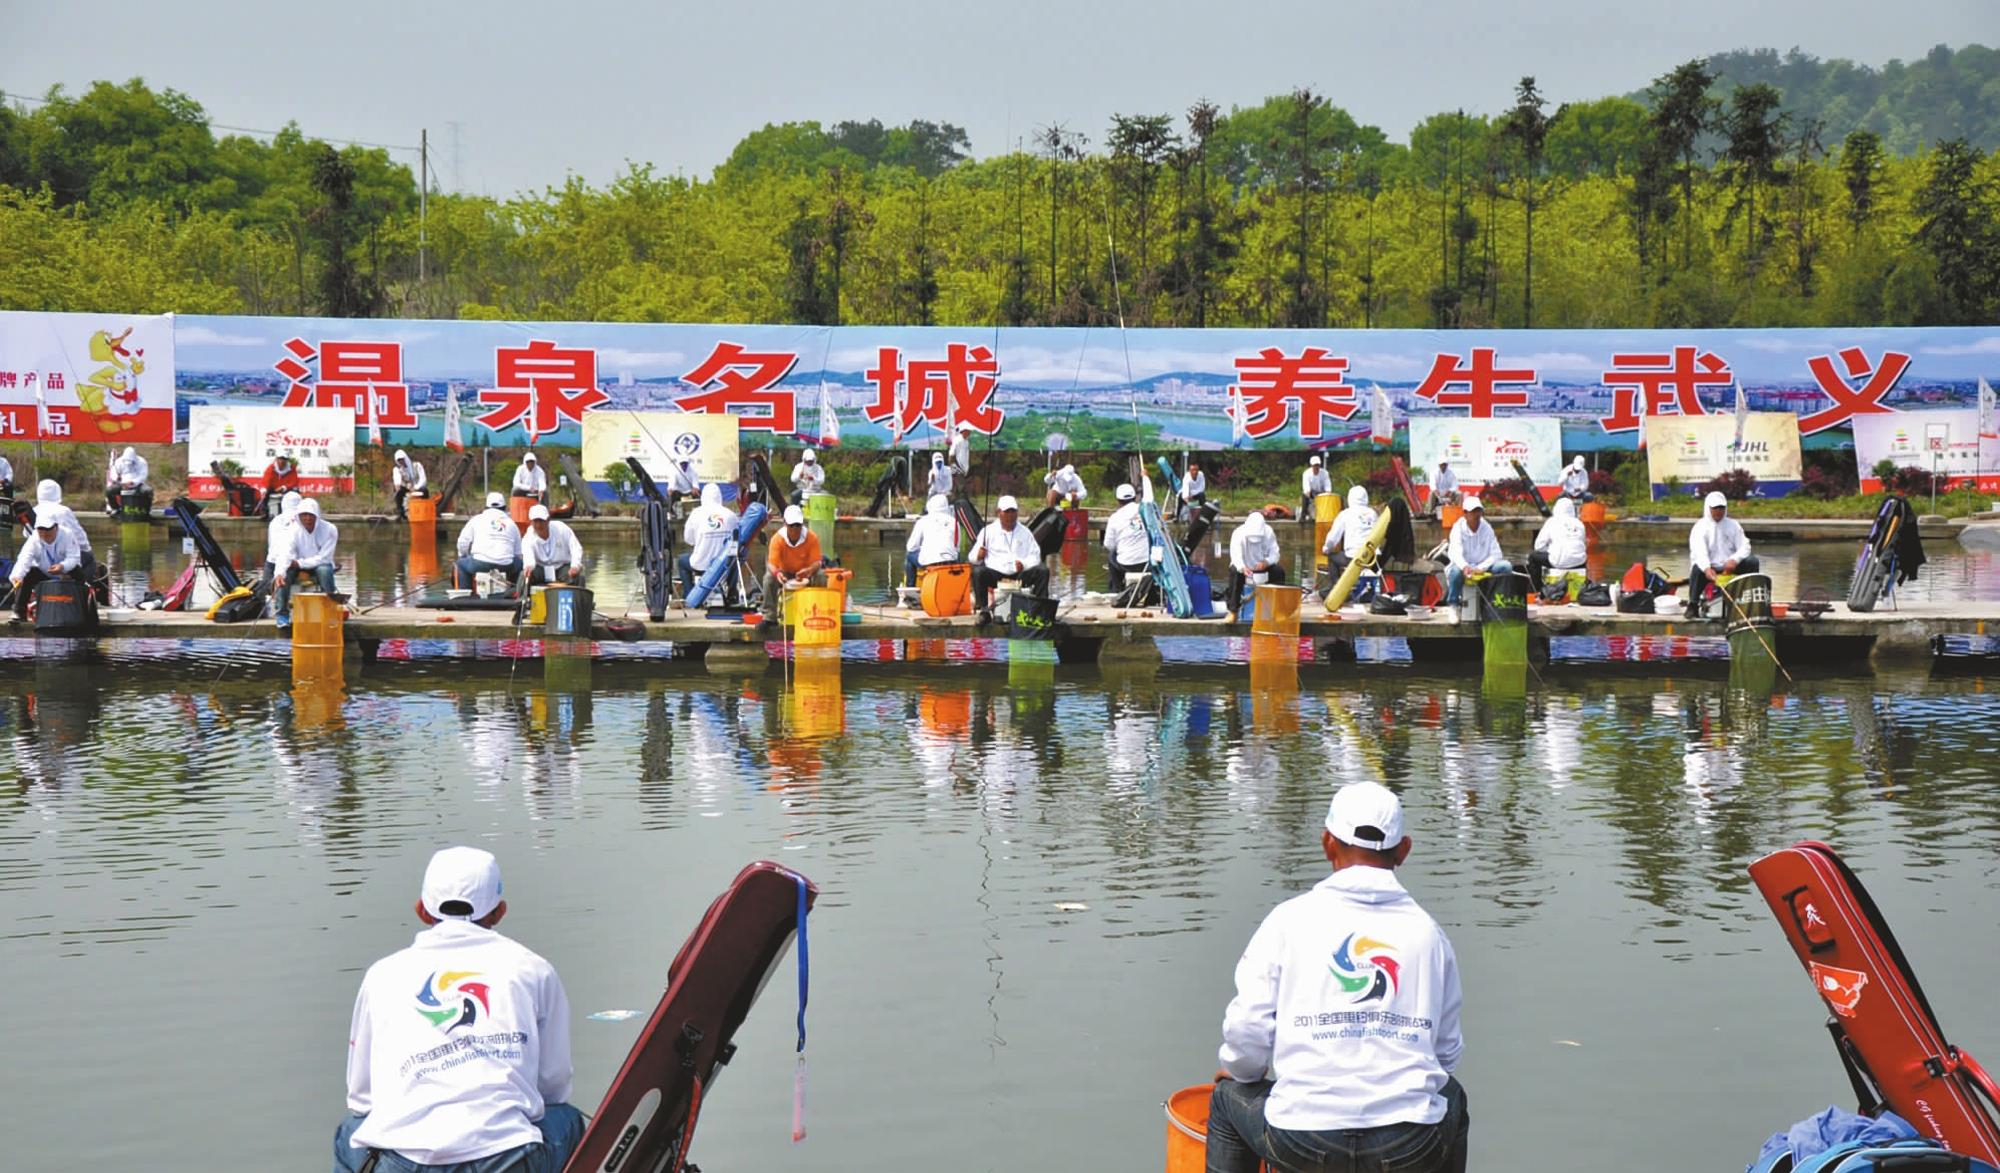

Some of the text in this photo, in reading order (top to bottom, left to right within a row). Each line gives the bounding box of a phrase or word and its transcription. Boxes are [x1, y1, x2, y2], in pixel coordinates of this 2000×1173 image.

[274, 336, 1913, 438] 温泉名城 养生武义
[282, 434, 331, 447] Sensa
[1741, 441, 1770, 453] JHL
